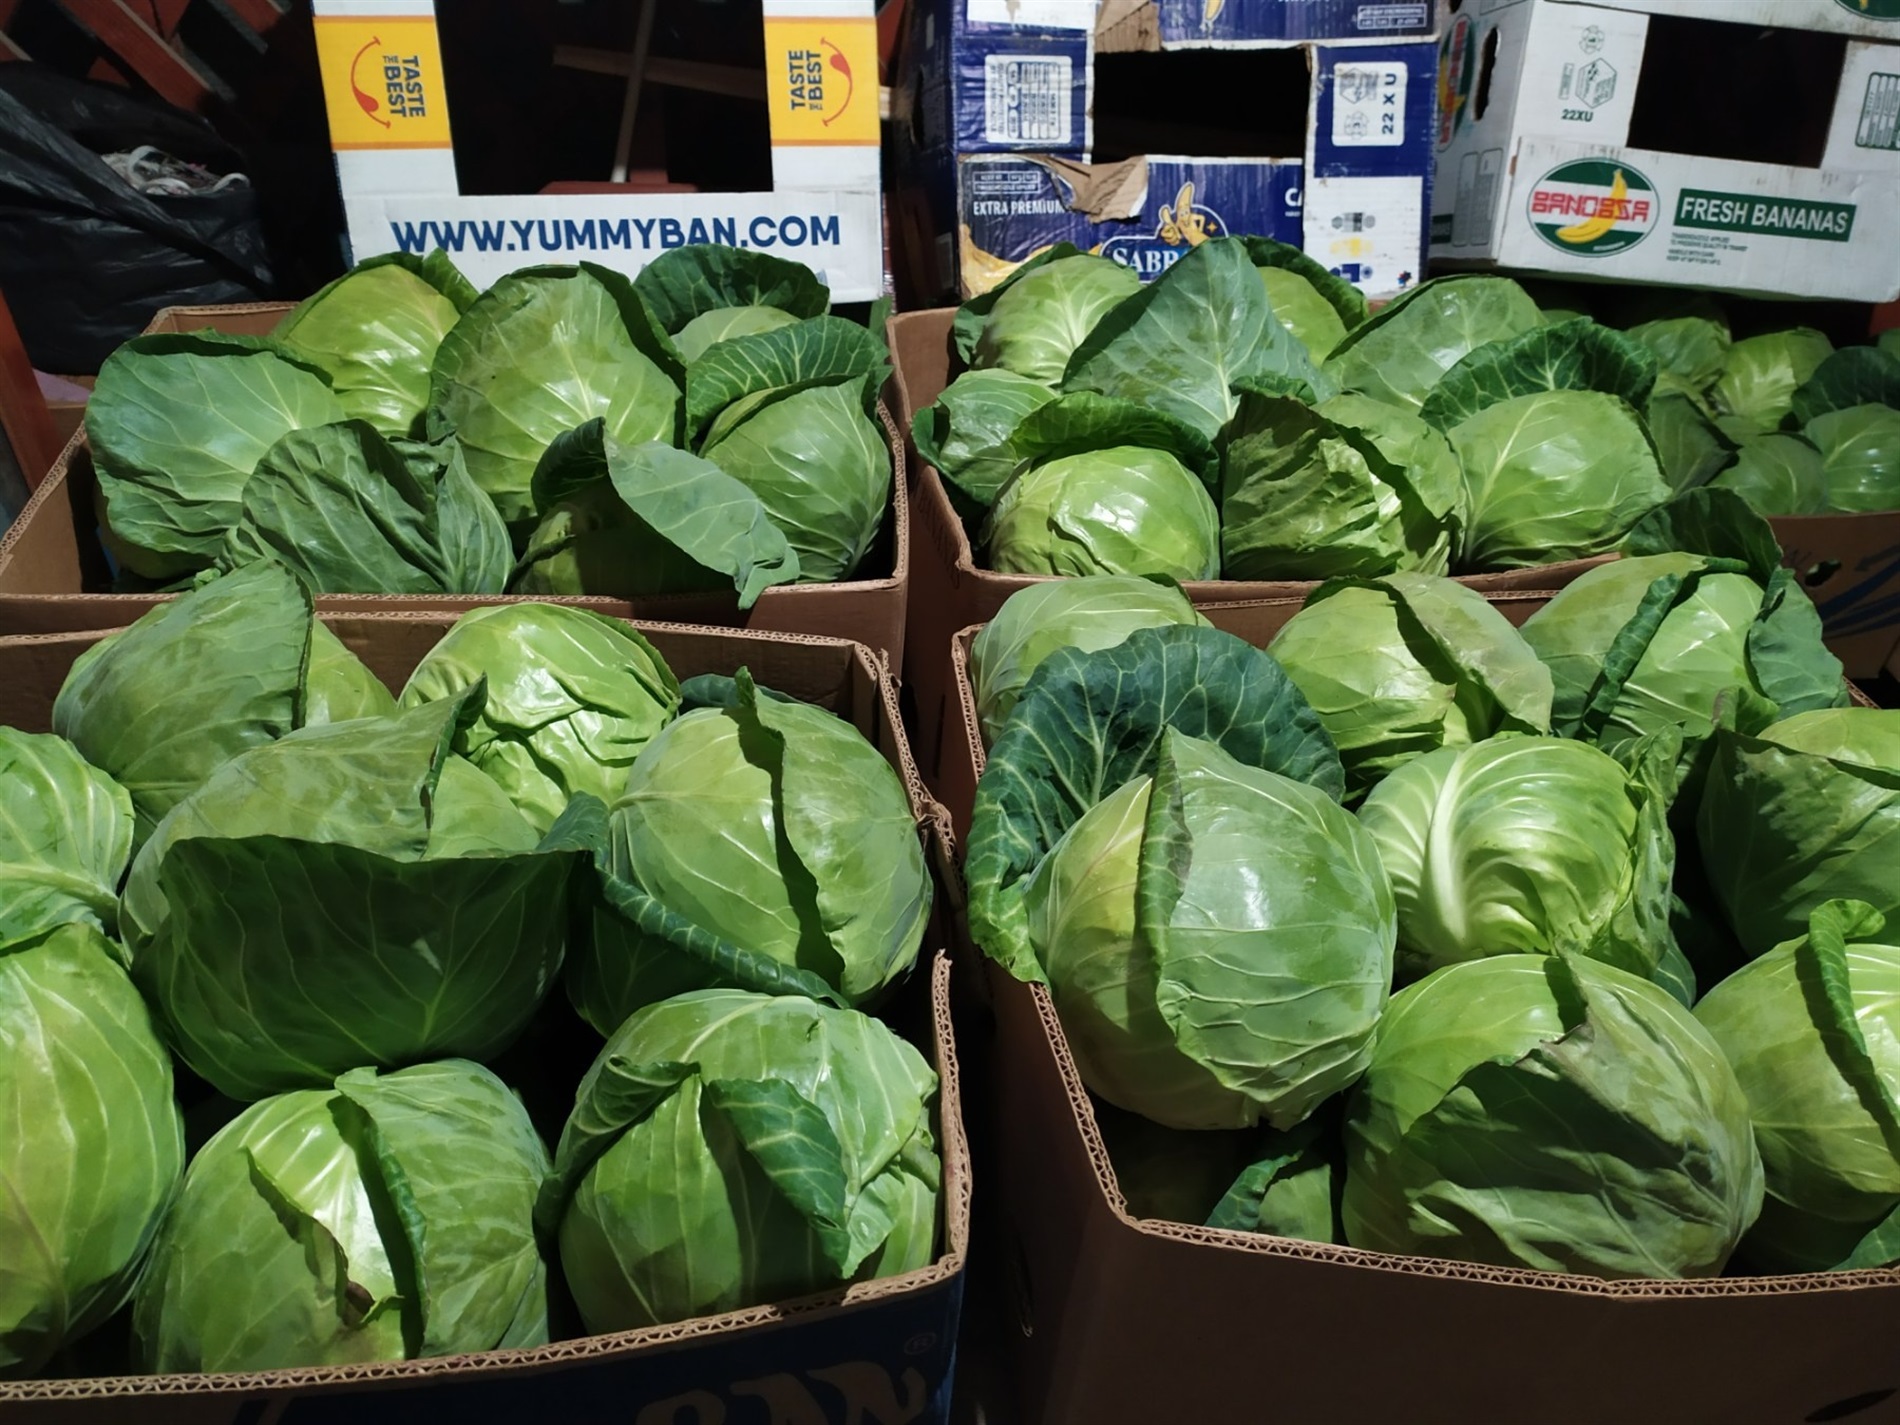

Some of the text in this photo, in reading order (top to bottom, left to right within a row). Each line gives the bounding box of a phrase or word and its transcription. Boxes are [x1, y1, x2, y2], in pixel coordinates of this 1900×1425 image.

[382, 55, 408, 118] THE BEST
[402, 55, 426, 118] TASTE
[788, 50, 806, 111] TASTE
[806, 50, 823, 101] BEST
[1381, 72, 1397, 135] 22 X U
[1561, 108, 1594, 123] 22XU
[973, 199, 1065, 216] EXTRA PREMIUM
[1681, 196, 1849, 234] FRESH BANANAS
[393, 214, 840, 253] WWW.YUMMYBAN.COM
